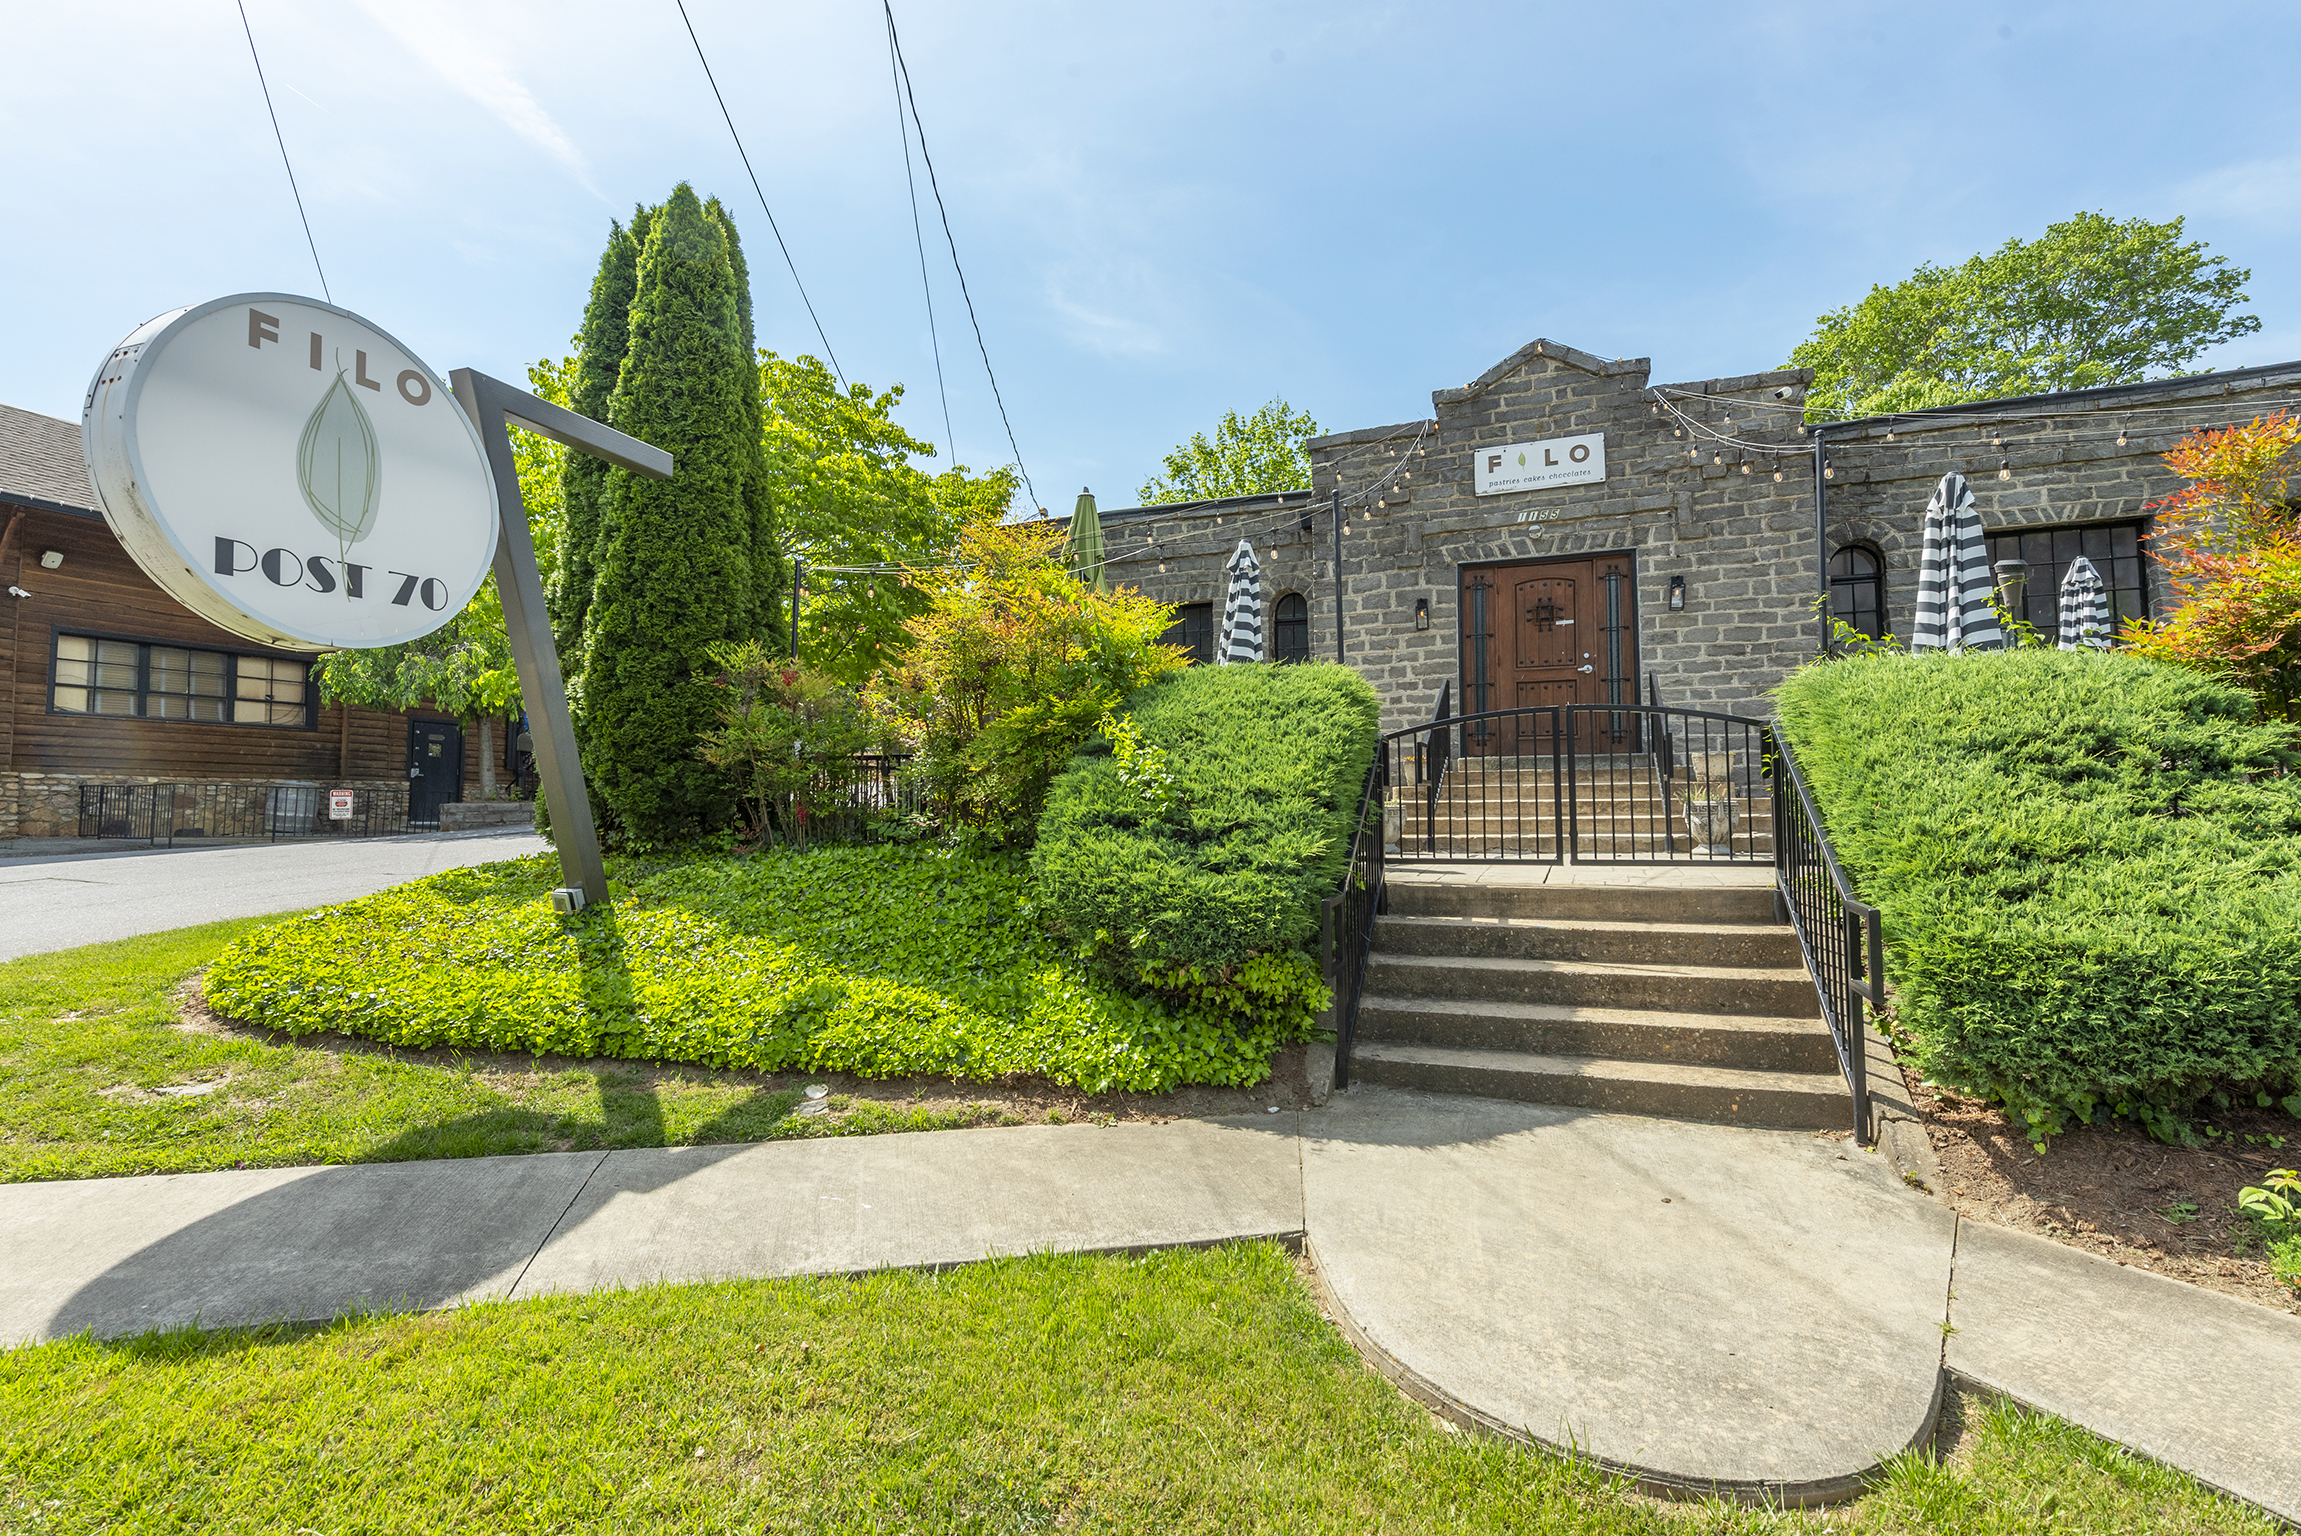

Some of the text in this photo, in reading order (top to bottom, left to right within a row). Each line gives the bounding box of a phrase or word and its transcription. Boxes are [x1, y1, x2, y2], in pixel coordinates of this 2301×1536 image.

[249, 308, 431, 406] FILO
[1488, 444, 1590, 474] FLO
[1489, 469, 1591, 488] pastries cakes chocolates
[1520, 510, 1558, 520] 1155
[214, 536, 373, 599] POST
[388, 570, 449, 612] 70
